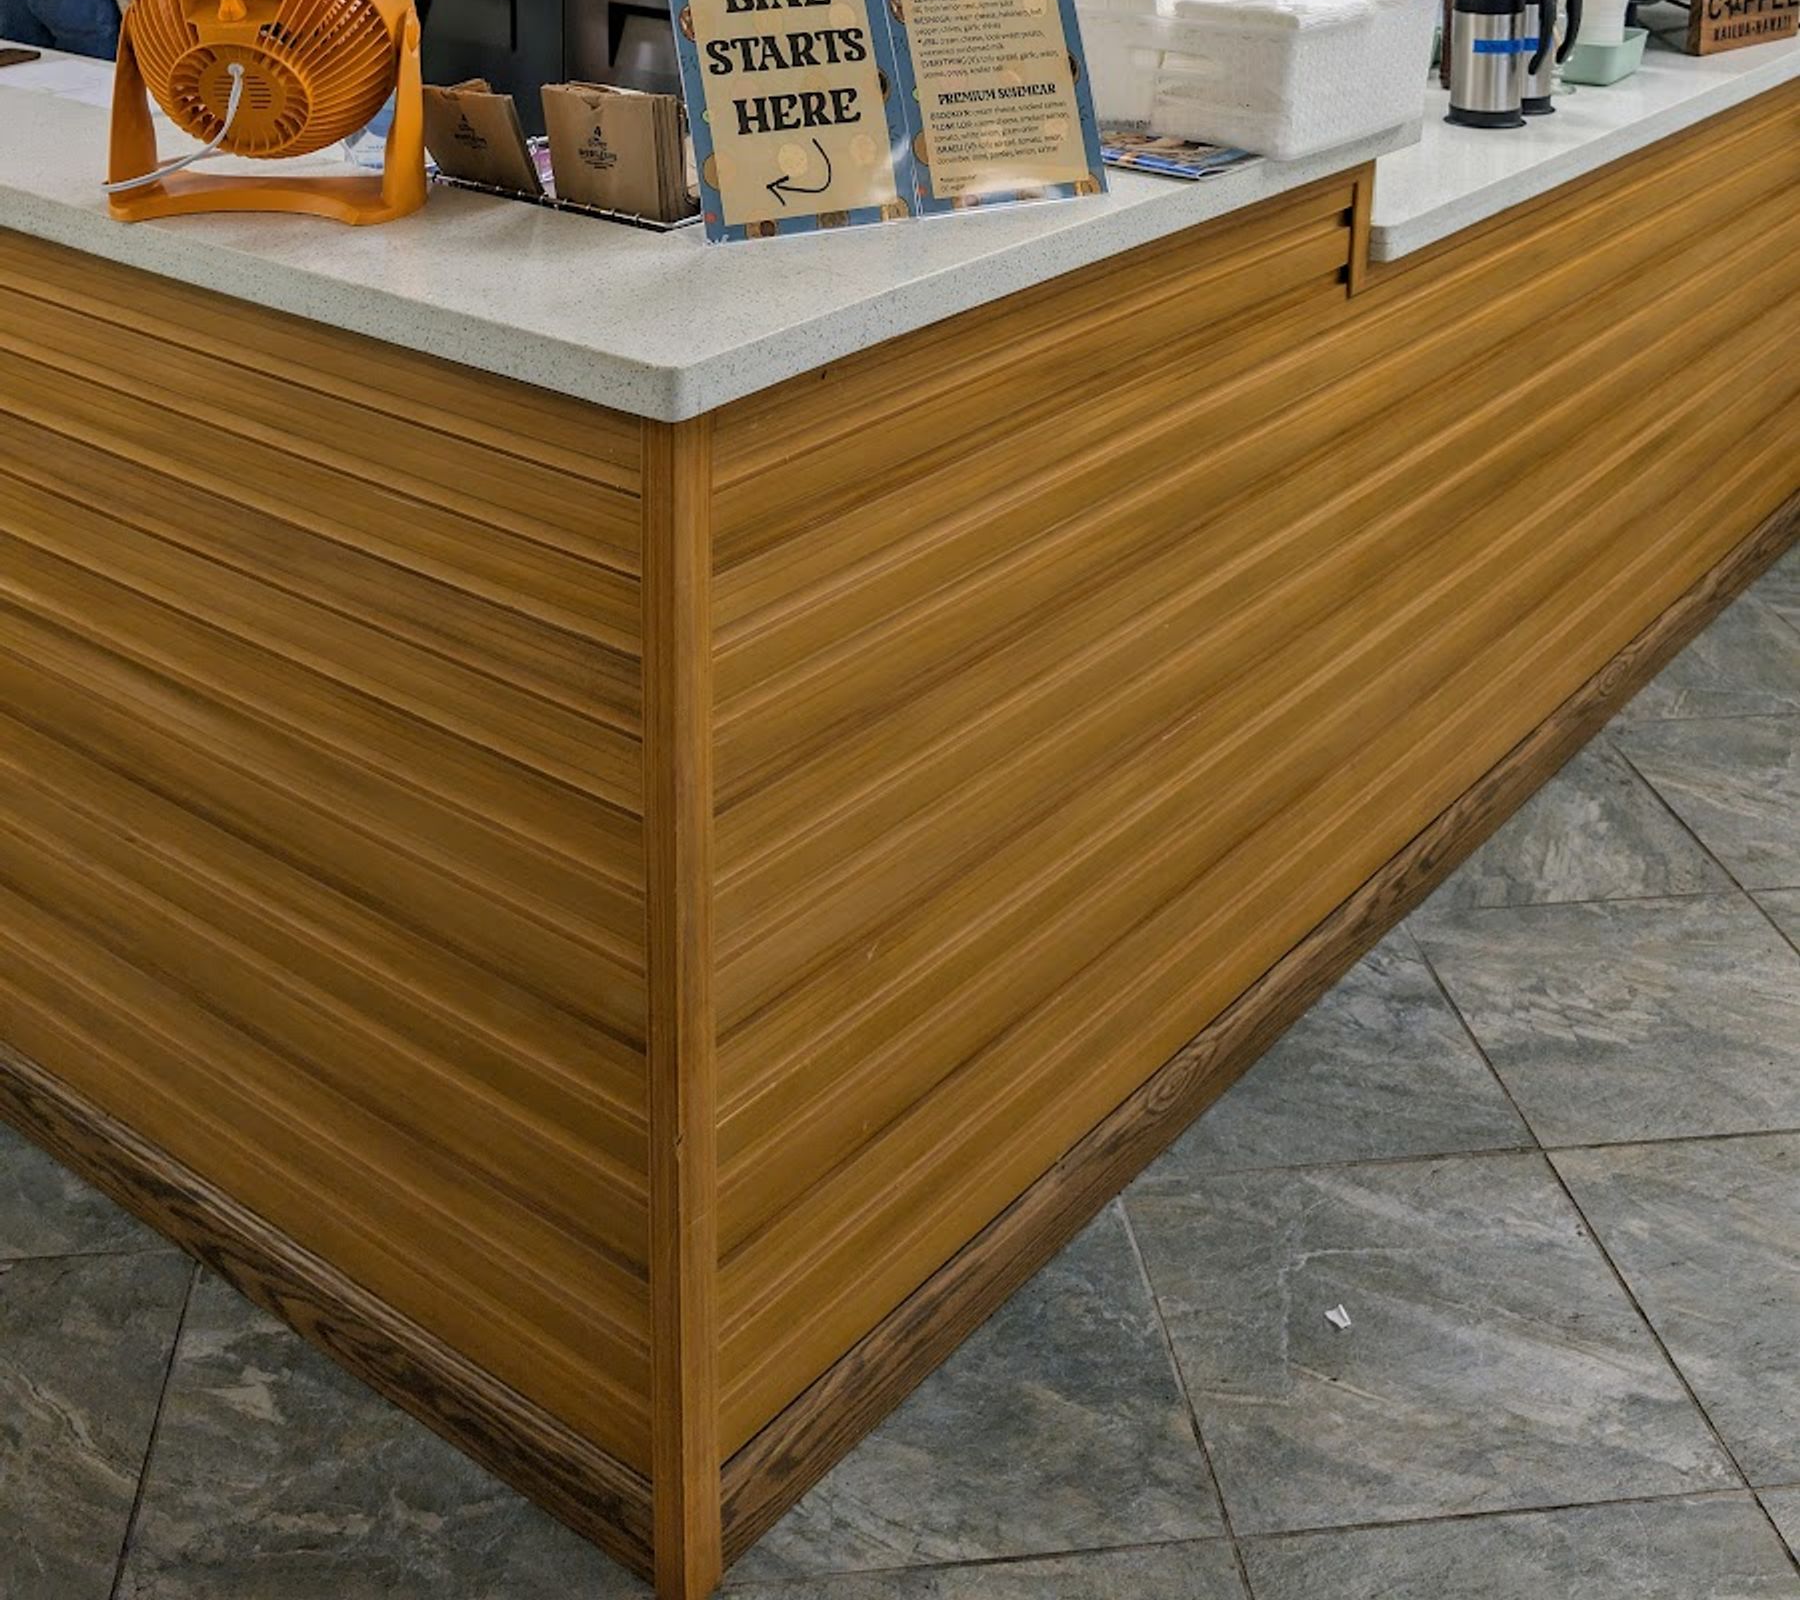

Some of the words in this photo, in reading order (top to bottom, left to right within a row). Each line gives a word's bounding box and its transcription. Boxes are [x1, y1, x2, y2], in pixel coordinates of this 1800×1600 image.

[706, 28, 867, 76] STARTS
[732, 87, 862, 136] HERE
[938, 88, 996, 106] PREMIUM
[997, 82, 1056, 99] SCHMEAR
